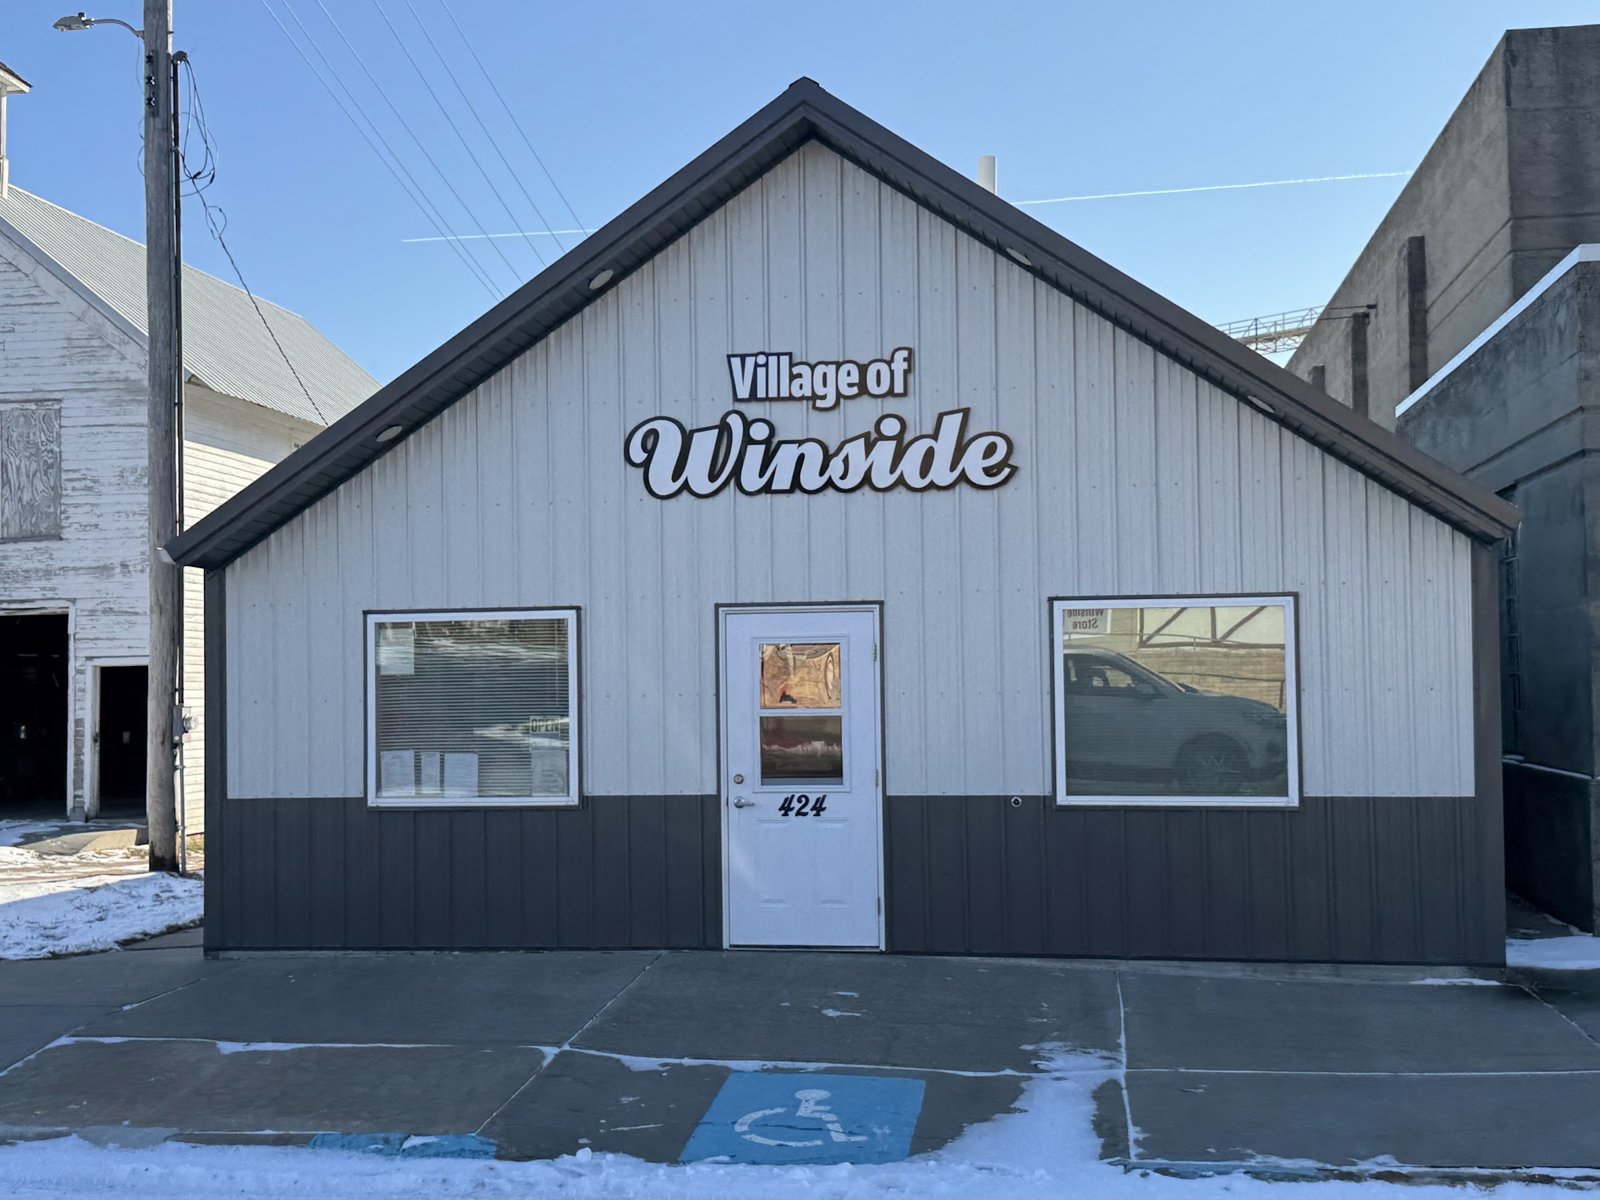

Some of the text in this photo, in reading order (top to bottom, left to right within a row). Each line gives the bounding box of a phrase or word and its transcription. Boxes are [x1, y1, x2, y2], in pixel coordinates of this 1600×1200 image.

[727, 346, 912, 410] Village of
[624, 407, 1018, 499] Winside
[531, 718, 560, 732] OPEN
[778, 794, 827, 817] 424
